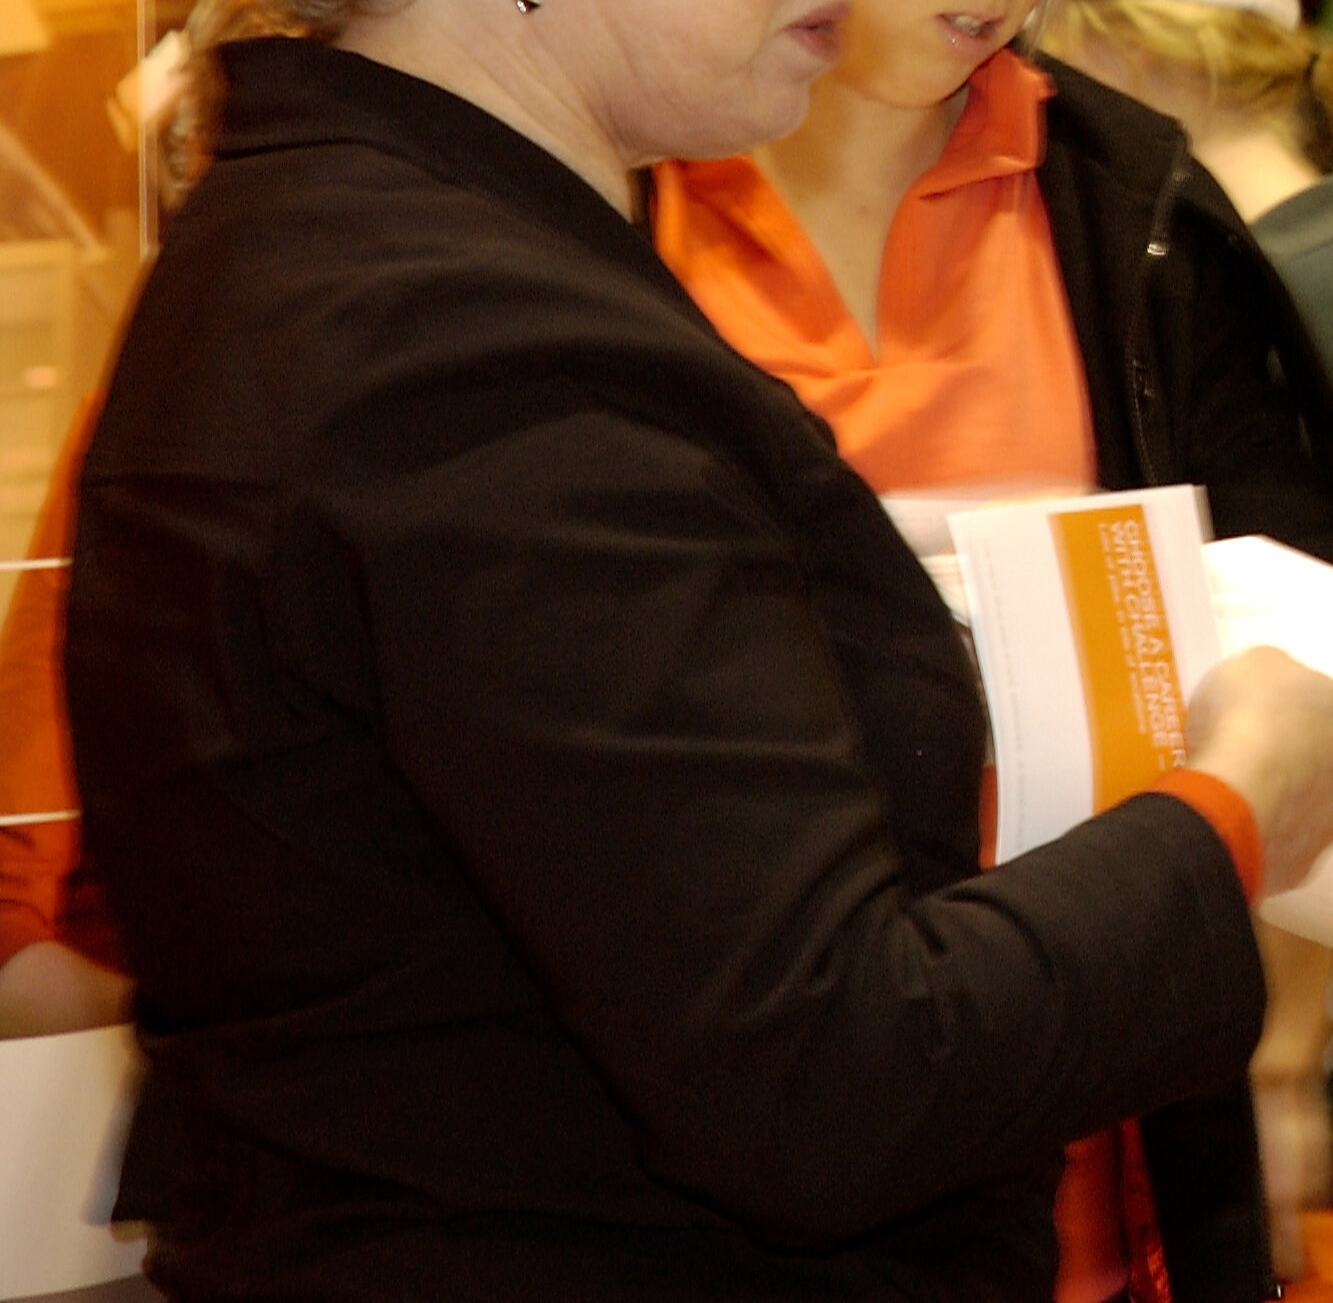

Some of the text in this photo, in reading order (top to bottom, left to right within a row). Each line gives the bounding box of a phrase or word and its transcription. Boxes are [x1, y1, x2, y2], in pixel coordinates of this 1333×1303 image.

[1110, 521, 1136, 588] WITH
[1125, 593, 1169, 749] CHALLENGE
[1124, 519, 1160, 630] CHOOSE
[1154, 659, 1186, 767] CAREER
